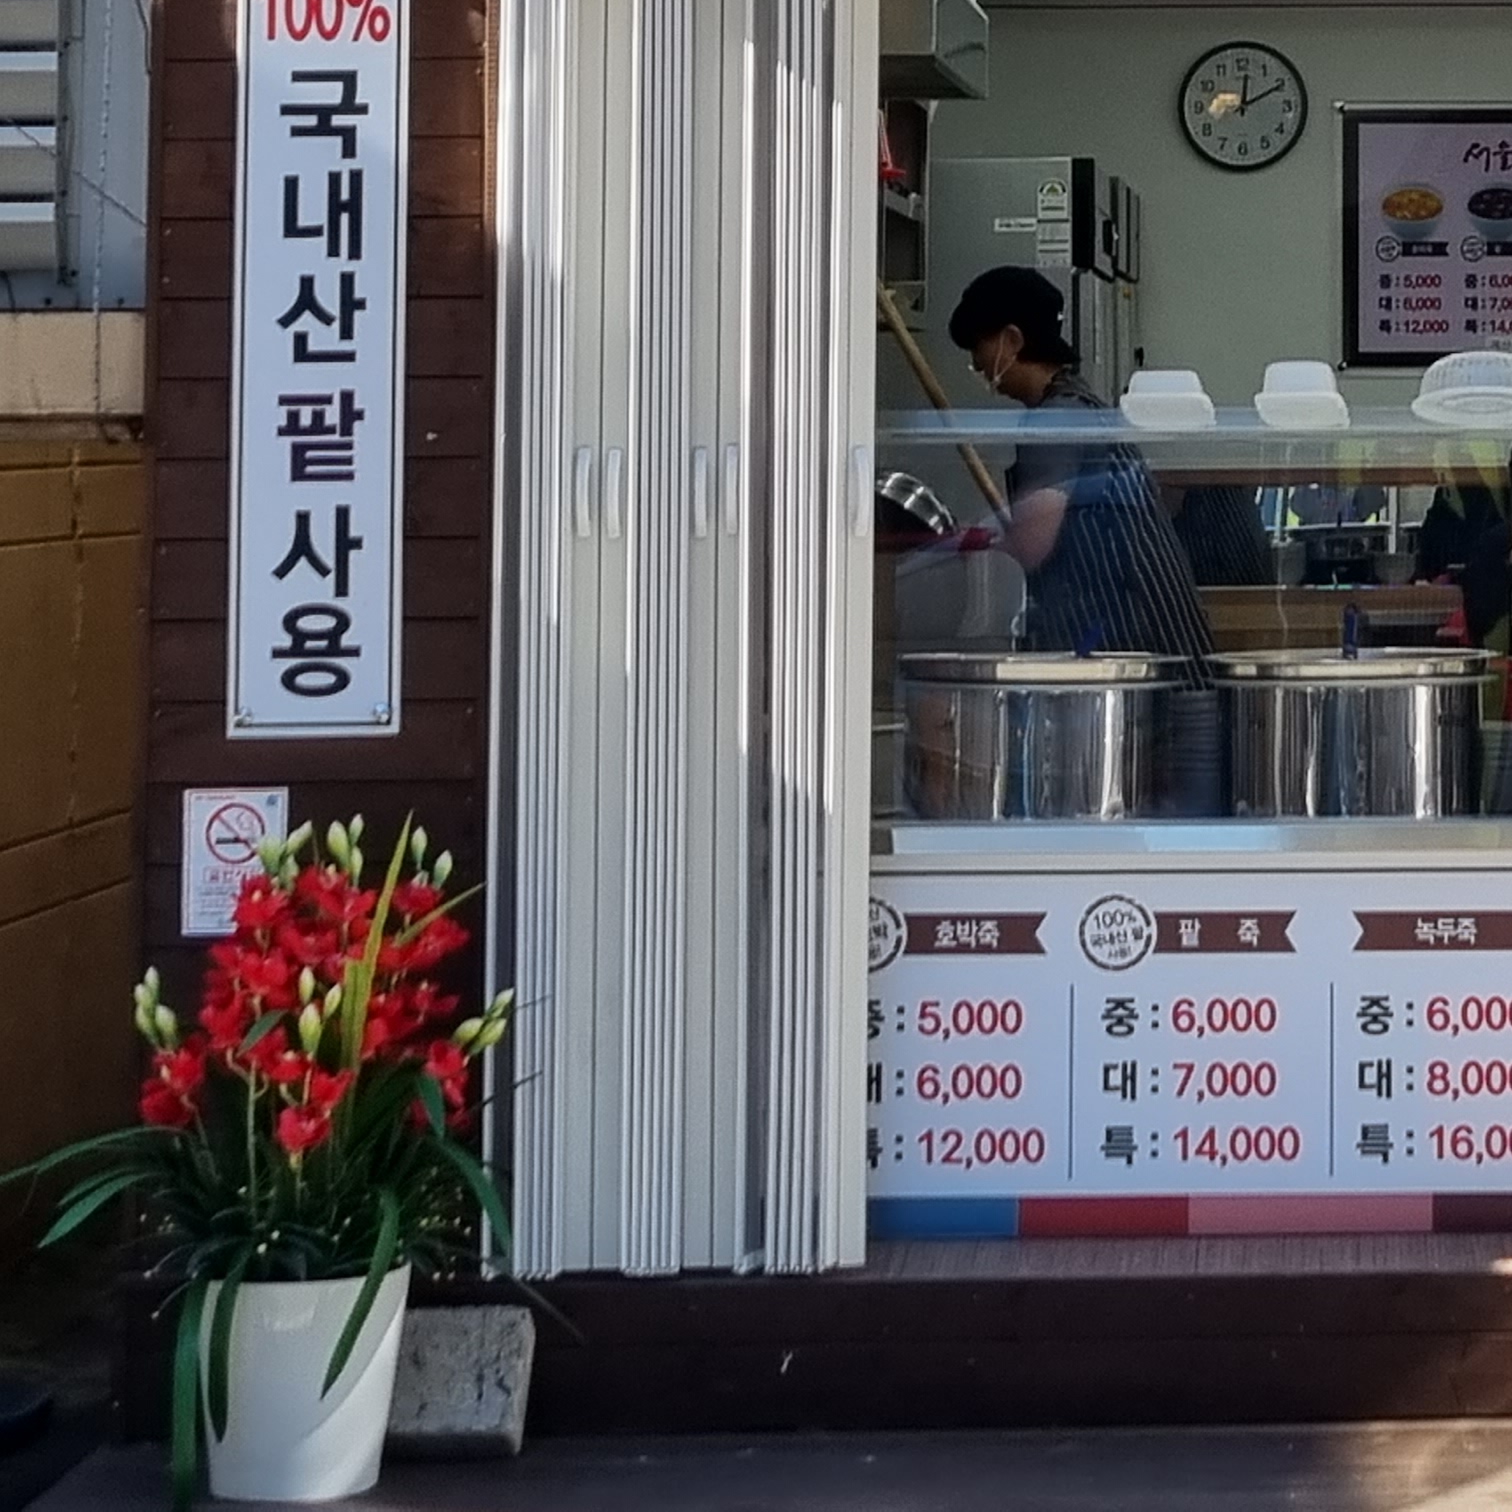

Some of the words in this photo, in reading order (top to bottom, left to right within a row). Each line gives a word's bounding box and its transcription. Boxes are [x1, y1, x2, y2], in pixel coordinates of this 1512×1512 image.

[276, 69, 369, 364] 국내산
[271, 504, 363, 698] 사용
[935, 920, 1000, 948] 호박죽
[1094, 908, 1137, 929] 100%
[1414, 918, 1477, 945] 녹두죽
[917, 999, 1023, 1040] 5,000
[1171, 998, 1277, 1038] 6,000
[916, 1063, 1022, 1105] 6,000
[1172, 1062, 1277, 1103] 7,000
[917, 1128, 1046, 1170] 12,000
[1173, 1126, 1300, 1168] 14,000
